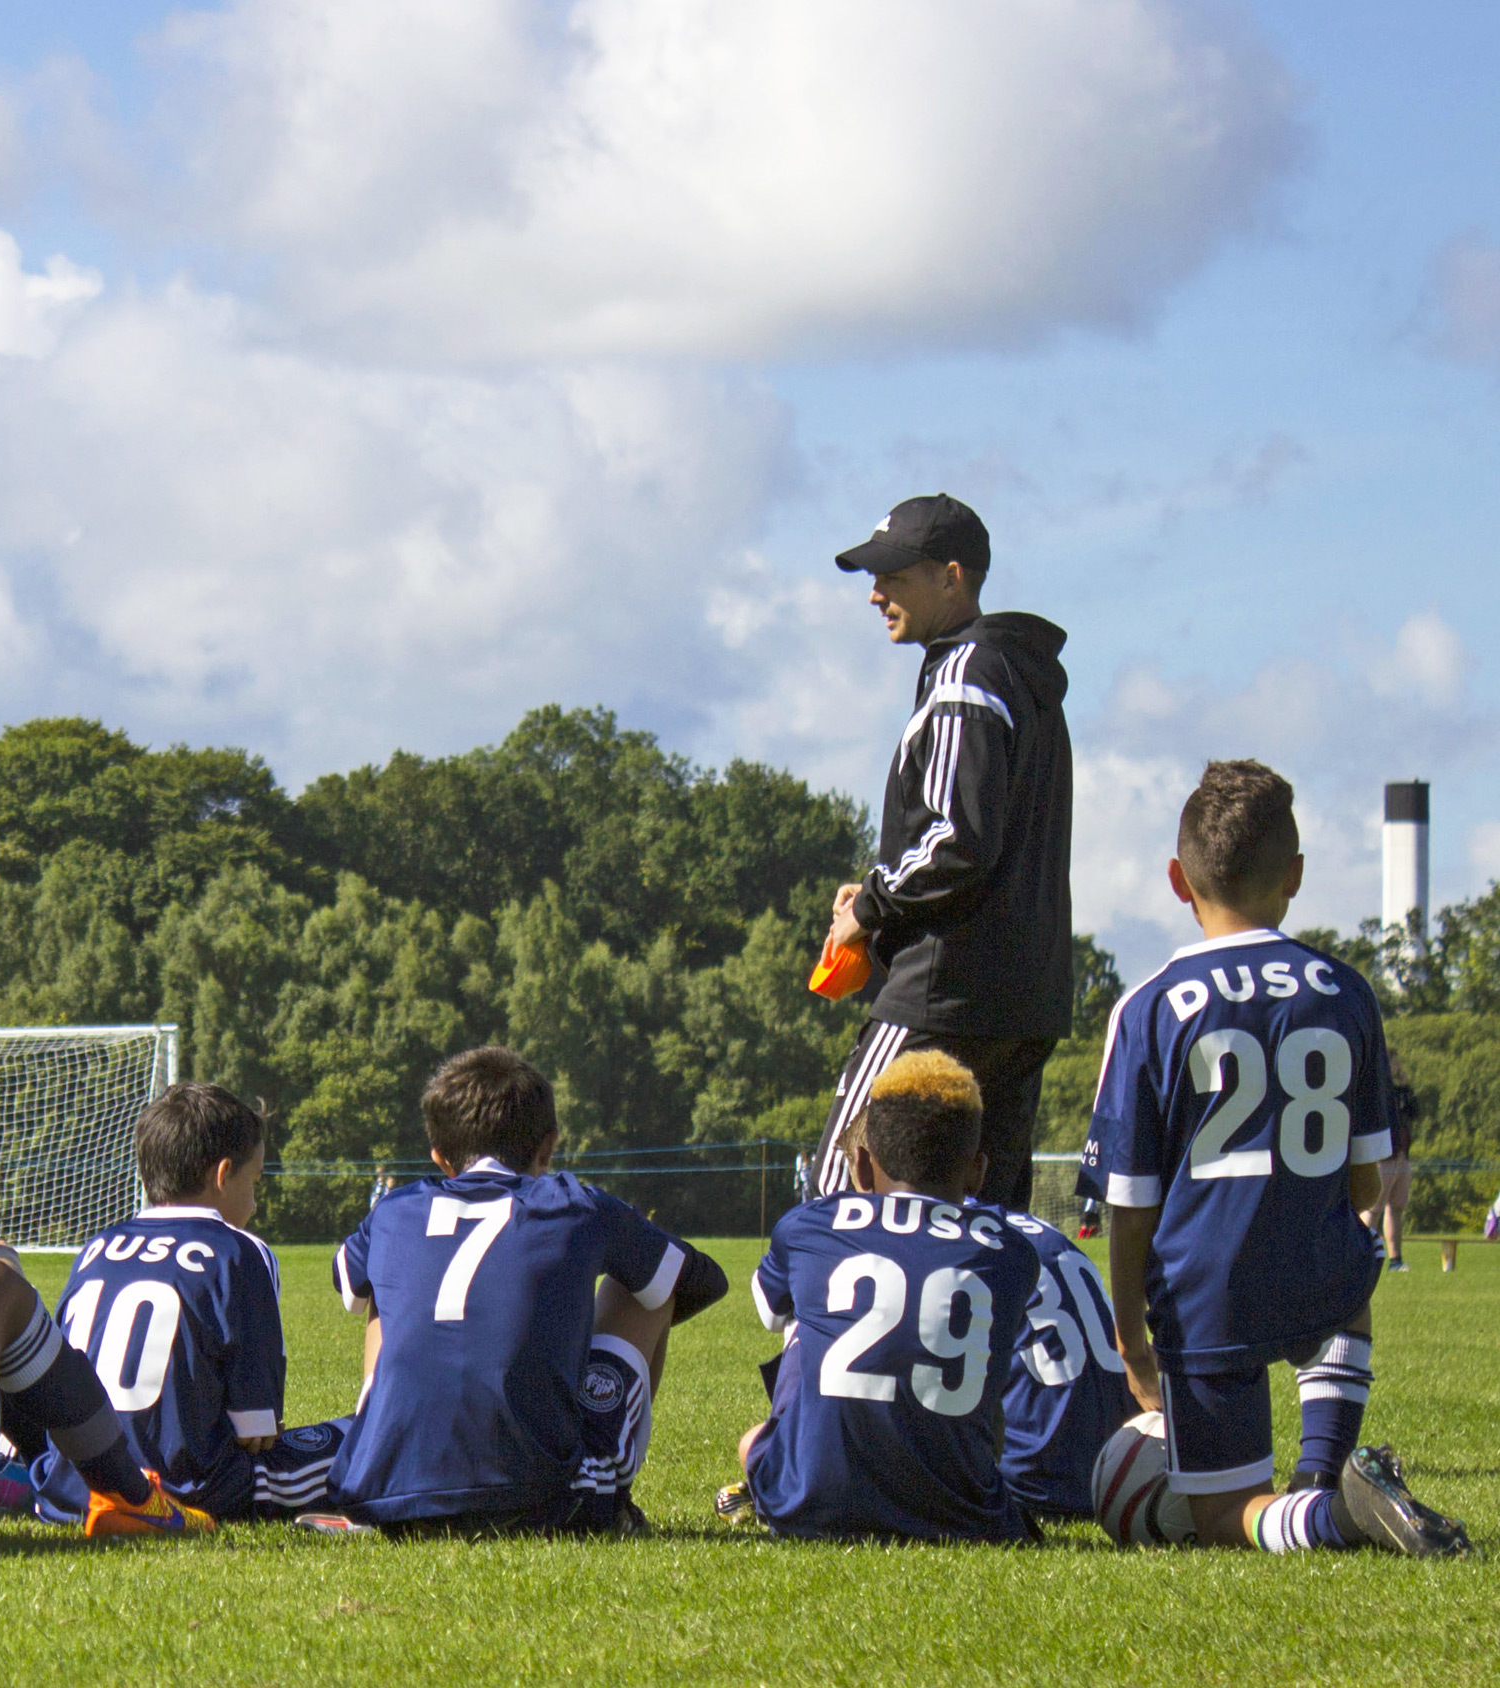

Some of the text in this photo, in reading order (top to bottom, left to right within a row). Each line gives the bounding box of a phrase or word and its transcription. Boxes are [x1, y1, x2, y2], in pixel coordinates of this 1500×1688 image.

[1167, 960, 1341, 1022] DUSC
[1084, 1139, 1099, 1155] M
[1188, 1028, 1352, 1179] 28
[77, 1235, 215, 1273] DUSC
[426, 1196, 513, 1321] 7
[832, 1197, 1005, 1250] DUSC
[65, 1279, 182, 1412] 10
[820, 1253, 994, 1417] 29
[1019, 1250, 1127, 1386] 30
